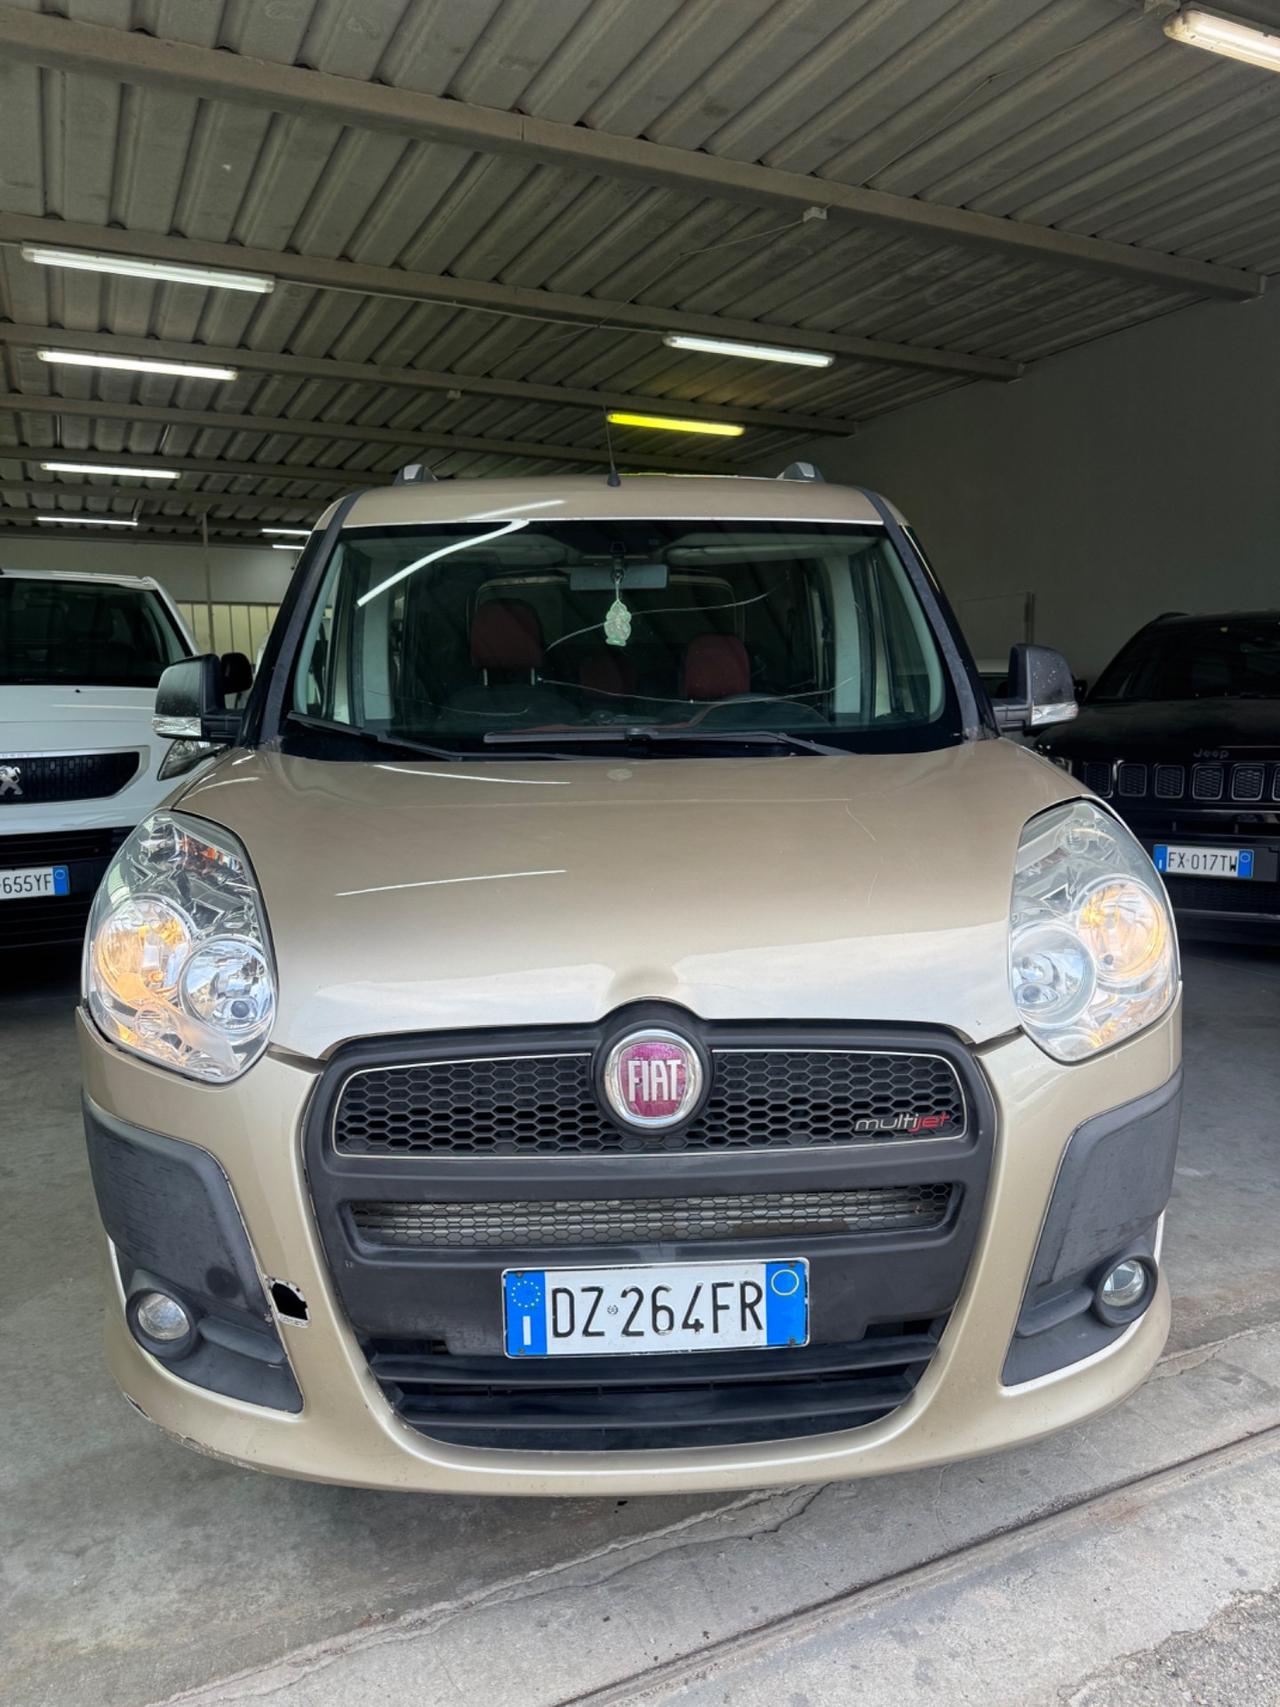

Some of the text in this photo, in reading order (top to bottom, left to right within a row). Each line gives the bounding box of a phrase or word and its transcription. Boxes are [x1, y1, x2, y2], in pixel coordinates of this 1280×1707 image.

[2, 873, 52, 894] 655YF
[627, 1058, 682, 1103] FIAT
[854, 1110, 950, 1134] multijet
